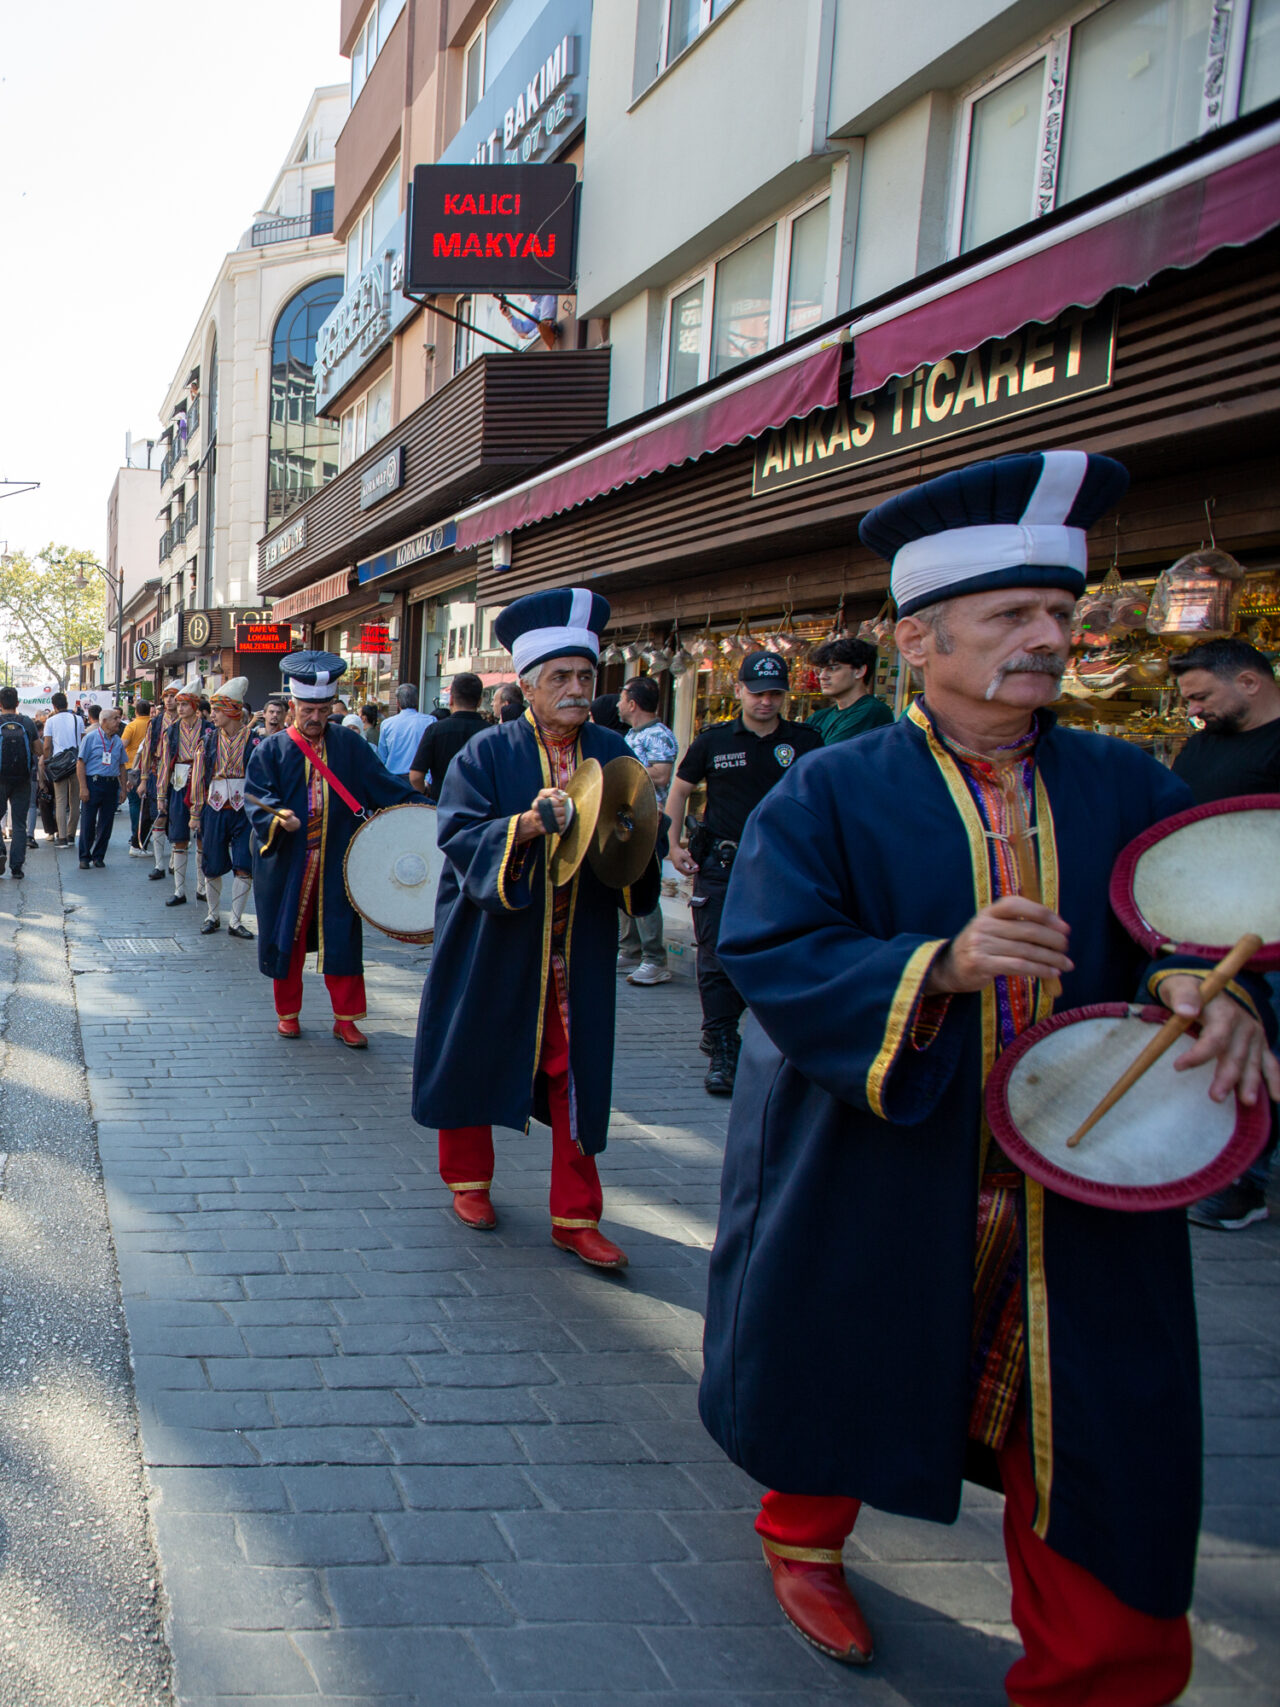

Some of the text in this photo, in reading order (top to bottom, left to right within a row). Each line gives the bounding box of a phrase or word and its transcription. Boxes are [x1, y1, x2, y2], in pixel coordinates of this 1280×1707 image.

[503, 35, 568, 149] BAKIMI
[522, 120, 542, 162] 07
[545, 92, 566, 136] 02
[444, 194, 521, 215] KALICI
[432, 232, 557, 258] MAKYAJ
[761, 400, 876, 478] ANKAS
[395, 533, 434, 567] KORKMAZ
[239, 641, 287, 650] MALZEMELERİ
[23, 697, 52, 705] DERNEĞ
